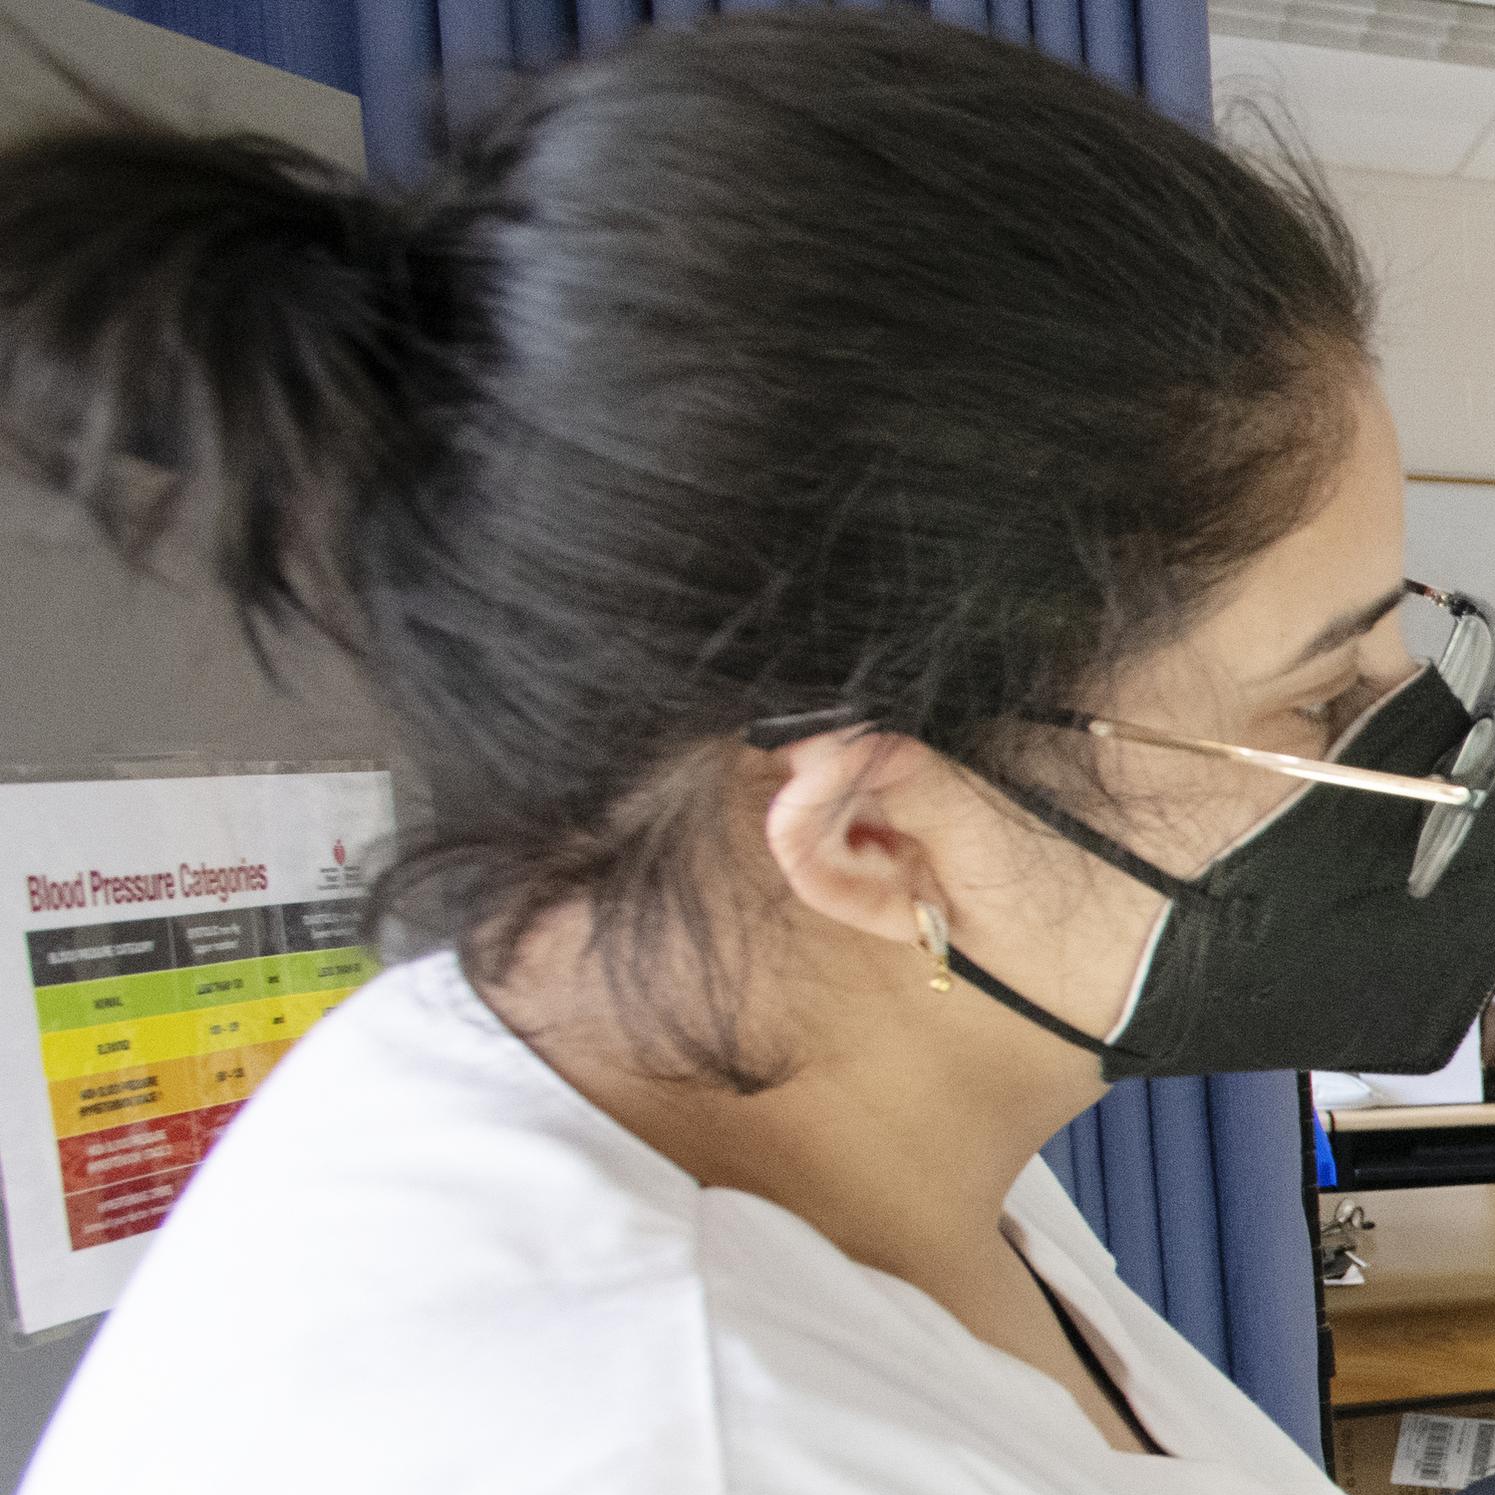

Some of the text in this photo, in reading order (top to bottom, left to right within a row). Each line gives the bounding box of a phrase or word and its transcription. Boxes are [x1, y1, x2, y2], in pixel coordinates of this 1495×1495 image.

[27, 857, 268, 912] Blood Pressure Categories
